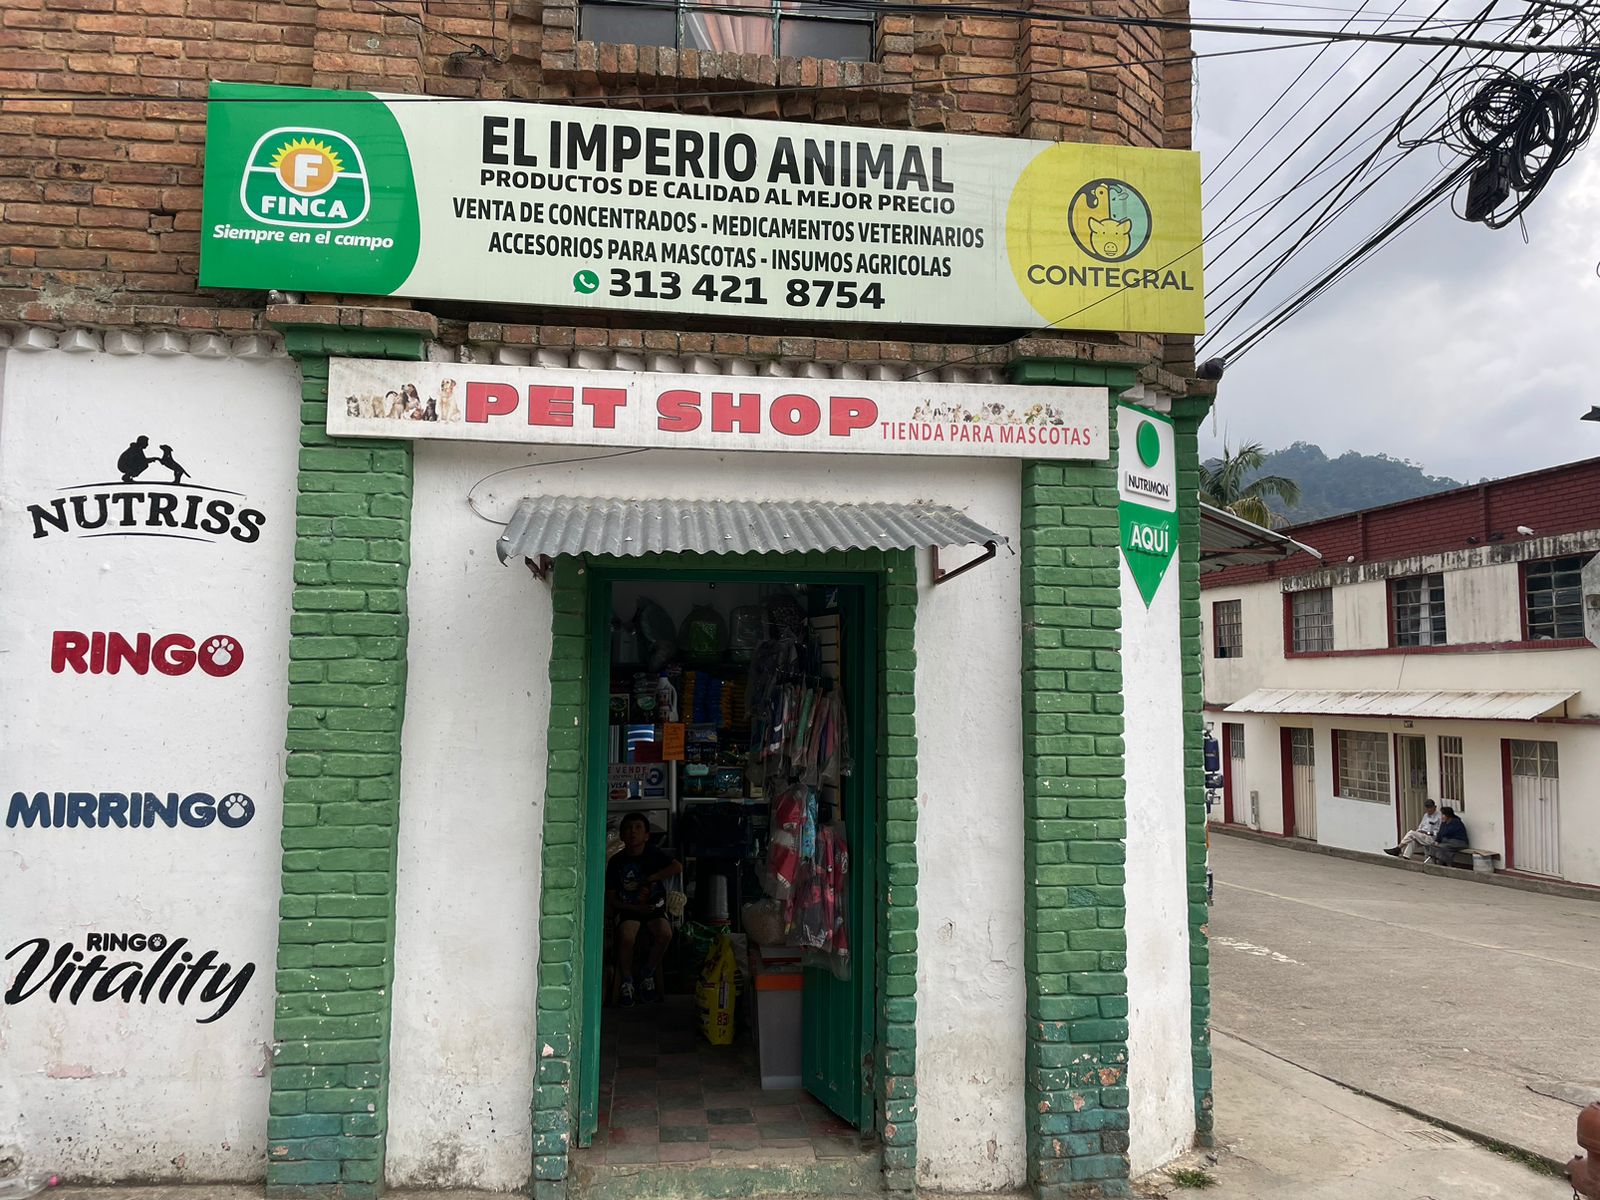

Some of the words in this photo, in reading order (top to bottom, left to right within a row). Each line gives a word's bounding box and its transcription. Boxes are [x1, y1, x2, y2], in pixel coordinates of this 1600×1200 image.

[482, 115, 538, 167] EL
[550, 120, 758, 182] IMPERIO
[766, 136, 954, 194] ANIMAL
[260, 195, 349, 220] FINCA
[480, 169, 623, 195] PRODUCTOS
[629, 178, 658, 197] DE
[663, 180, 760, 204] CALIDAD
[764, 187, 793, 206] AL
[797, 189, 873, 211] MEJOR
[879, 194, 955, 215] PRECIO
[212, 224, 285, 244] Siempre
[288, 231, 312, 243] en
[315, 230, 331, 246] el
[335, 234, 395, 251] campo
[453, 197, 516, 222] VENTA
[520, 201, 544, 224] DE
[548, 203, 697, 234] CONCENTRADOS
[712, 214, 855, 242] MEDICAMENTOS
[858, 221, 984, 249] VETERINARIOS
[488, 232, 604, 259] ACCESORIOS
[608, 239, 657, 263] PARA
[661, 242, 756, 269] MASCOTAS
[772, 249, 853, 274] INSUMOS
[856, 252, 951, 277] AGRICOLAS
[609, 268, 682, 300] 313
[691, 274, 768, 305] 421
[785, 279, 886, 309] 8754
[1027, 264, 1194, 291] CONTEGRAL
[465, 381, 627, 429] PET
[656, 389, 878, 437] SHOP
[881, 421, 945, 442] TIENDA
[950, 422, 994, 443] PARA
[1000, 424, 1091, 445] MASCOTAS
[1128, 474, 1169, 497] NUTRIMON
[26, 492, 267, 543] NUTRISS
[1131, 525, 1169, 554] AQUÍ
[51, 631, 245, 678] RINGO
[5, 791, 256, 829] MIRRINGO
[86, 932, 168, 952] RINGO
[4, 937, 256, 1024] Vitality
